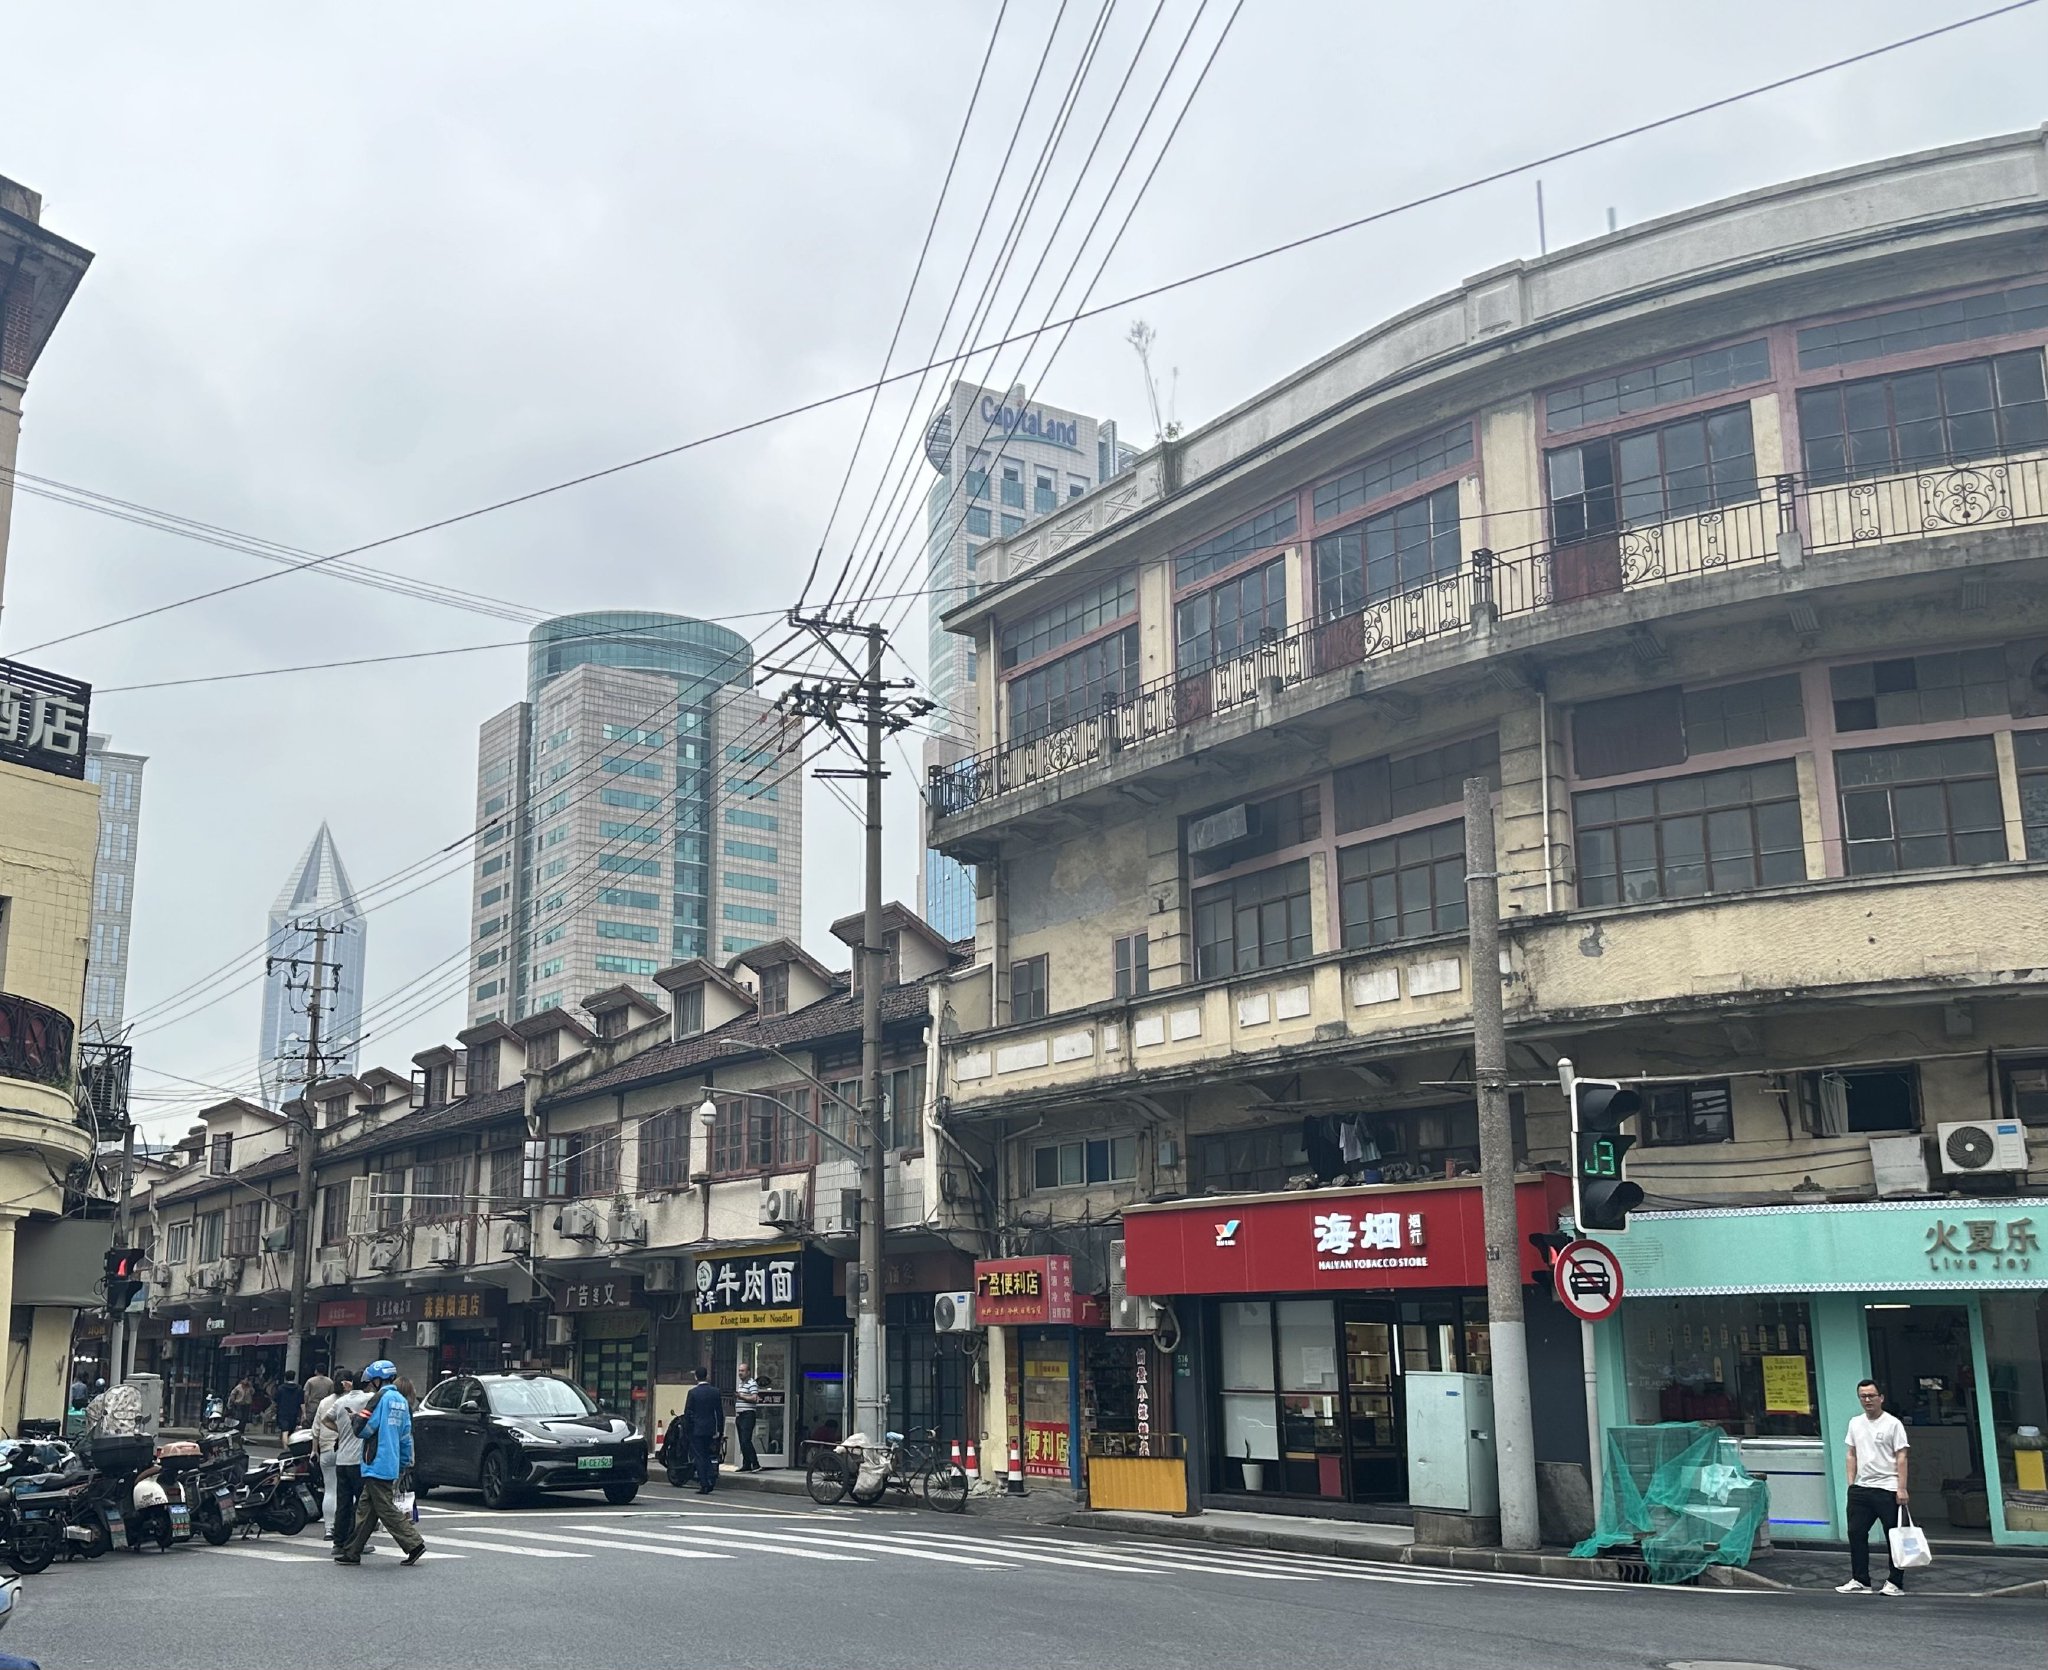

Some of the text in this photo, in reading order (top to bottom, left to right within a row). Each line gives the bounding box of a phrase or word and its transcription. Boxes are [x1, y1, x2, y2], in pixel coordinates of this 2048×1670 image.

[981, 395, 1077, 446] CapitaLand
[1314, 1212, 1401, 1255] 海烟
[1925, 1217, 2041, 1255] 火夏乐
[1318, 1257, 1428, 1271] HAIYAN TOBACCO STORE
[716, 1260, 795, 1306] 牛肉面
[977, 1271, 1039, 1296] 广盈便利店
[753, 1313, 766, 1323] Beef
[770, 1312, 793, 1323] Noodles
[1028, 1429, 1069, 1462] 便利店
